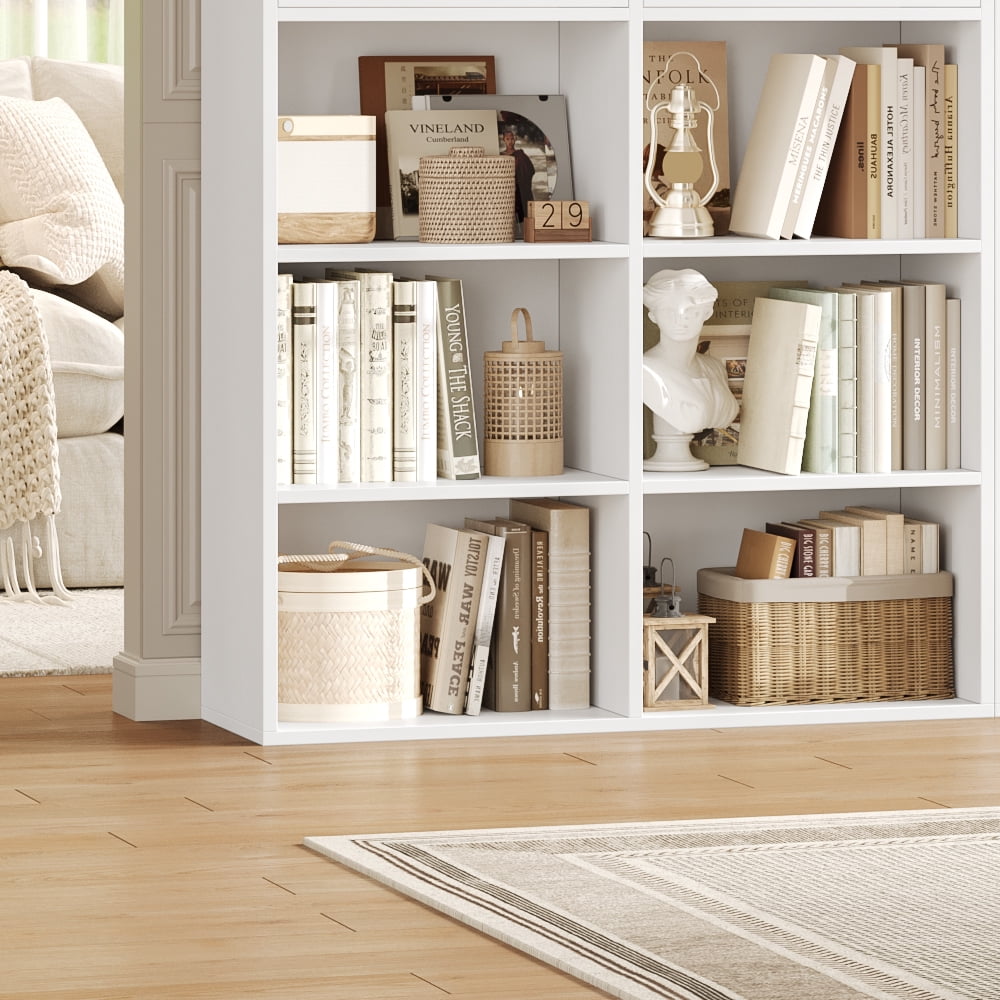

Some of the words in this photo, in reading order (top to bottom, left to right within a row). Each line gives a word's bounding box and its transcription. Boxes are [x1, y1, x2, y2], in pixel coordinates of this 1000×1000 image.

[410, 124, 485, 133] VINELAND
[825, 103, 841, 136] JUSTICE
[792, 146, 811, 204] MERINGUES
[810, 87, 829, 145] MACARONS
[818, 131, 831, 159] THIN
[813, 158, 825, 182] THE
[541, 202, 583, 228] 29
[444, 303, 464, 352] YOUNG
[448, 365, 466, 393] THE
[453, 395, 472, 440] SHACK
[803, 534, 813, 544] BIG
[819, 534, 829, 544] BIG
[803, 546, 813, 564] STONE
[803, 565, 813, 577] GAP
